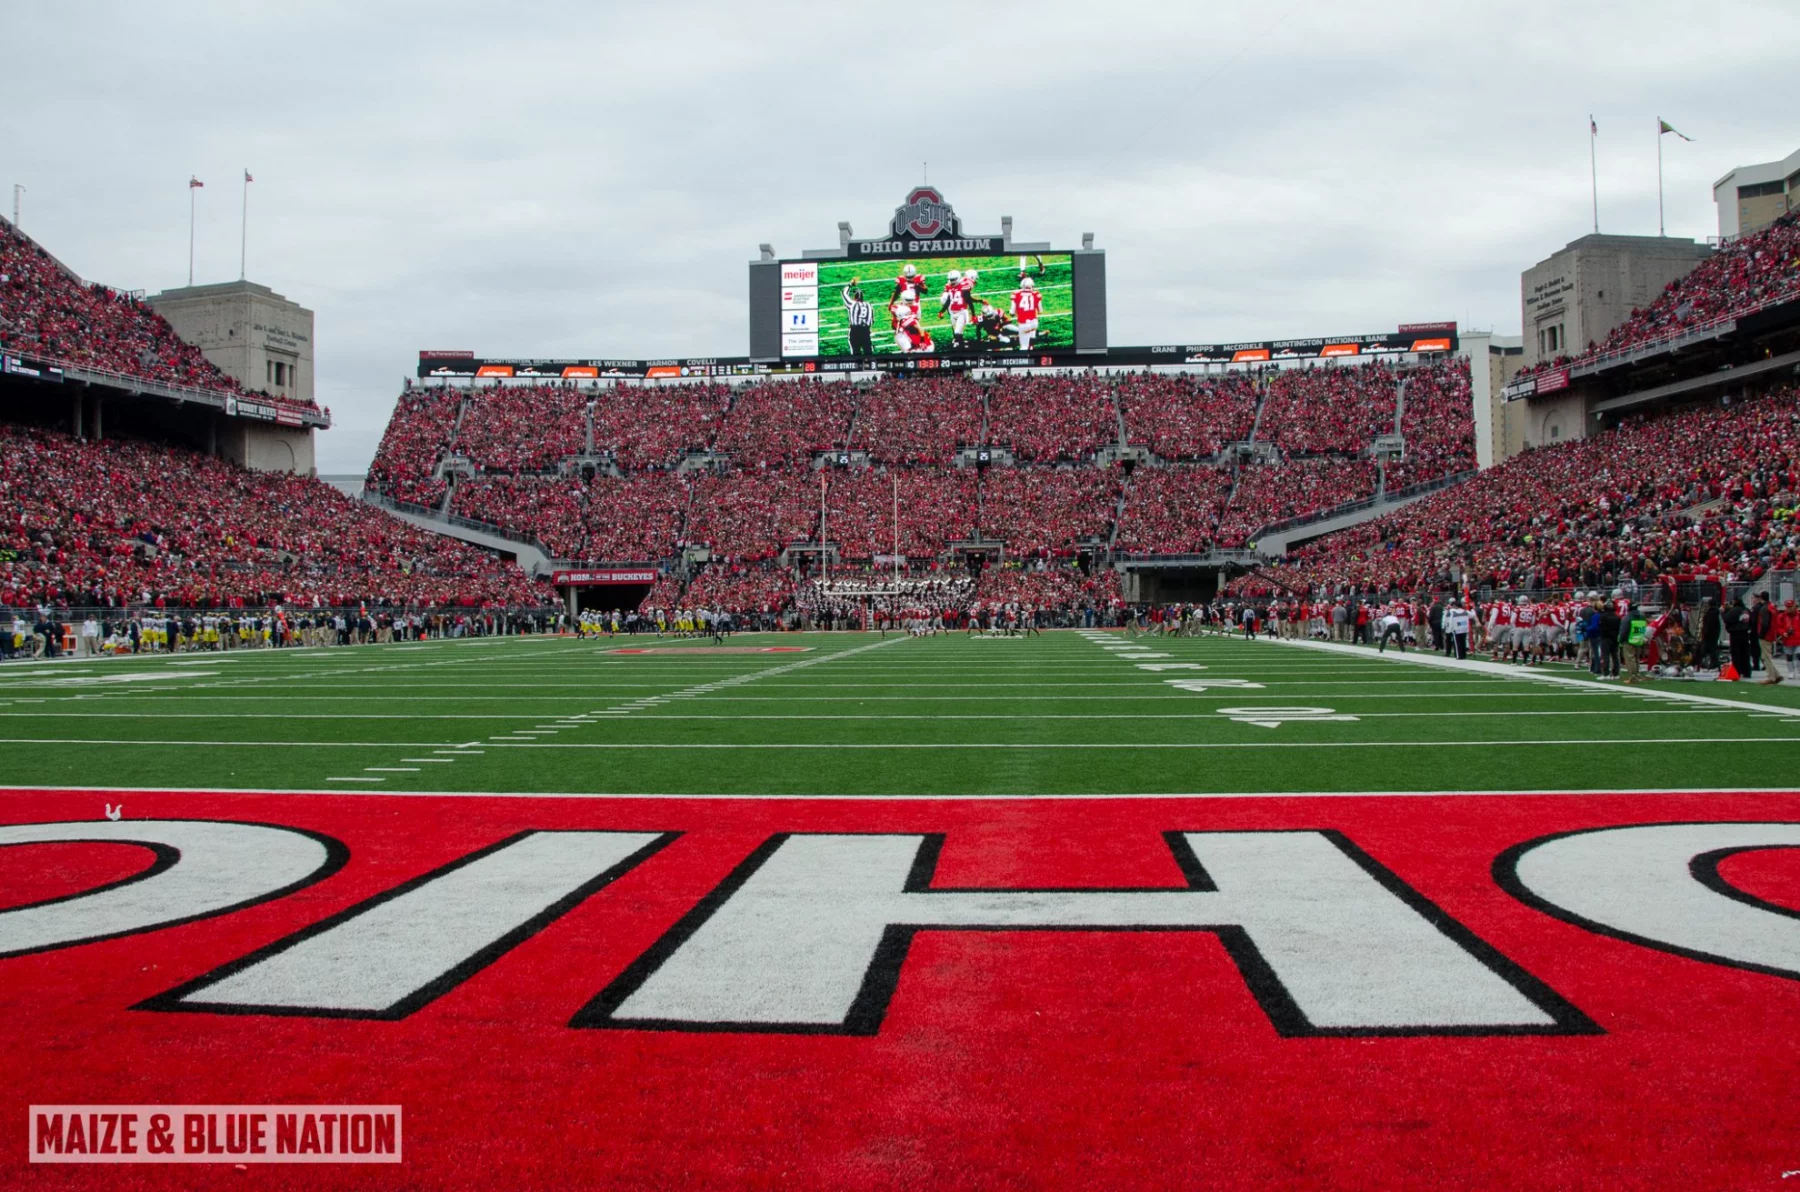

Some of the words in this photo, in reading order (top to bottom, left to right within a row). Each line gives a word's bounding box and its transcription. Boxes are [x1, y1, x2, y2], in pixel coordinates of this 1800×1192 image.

[860, 241, 903, 254] OHIO
[908, 239, 991, 253] STADIUM
[784, 268, 815, 280] meijer
[1019, 292, 1035, 311] 41
[1273, 339, 1323, 348] HUNTINGTON
[1325, 336, 1364, 345] NATIONAL
[1366, 334, 1388, 343] BANK
[686, 358, 717, 366] COVELLI
[918, 359, 939, 368] 13:31
[940, 360, 950, 368] 20
[1002, 358, 1029, 366] MICHIGAN
[1041, 357, 1052, 365] 21
[805, 363, 815, 372] 28
[570, 573, 594, 581] HOM
[612, 572, 654, 581] BUCKEYES
[1519, 611, 1532, 622] 96
